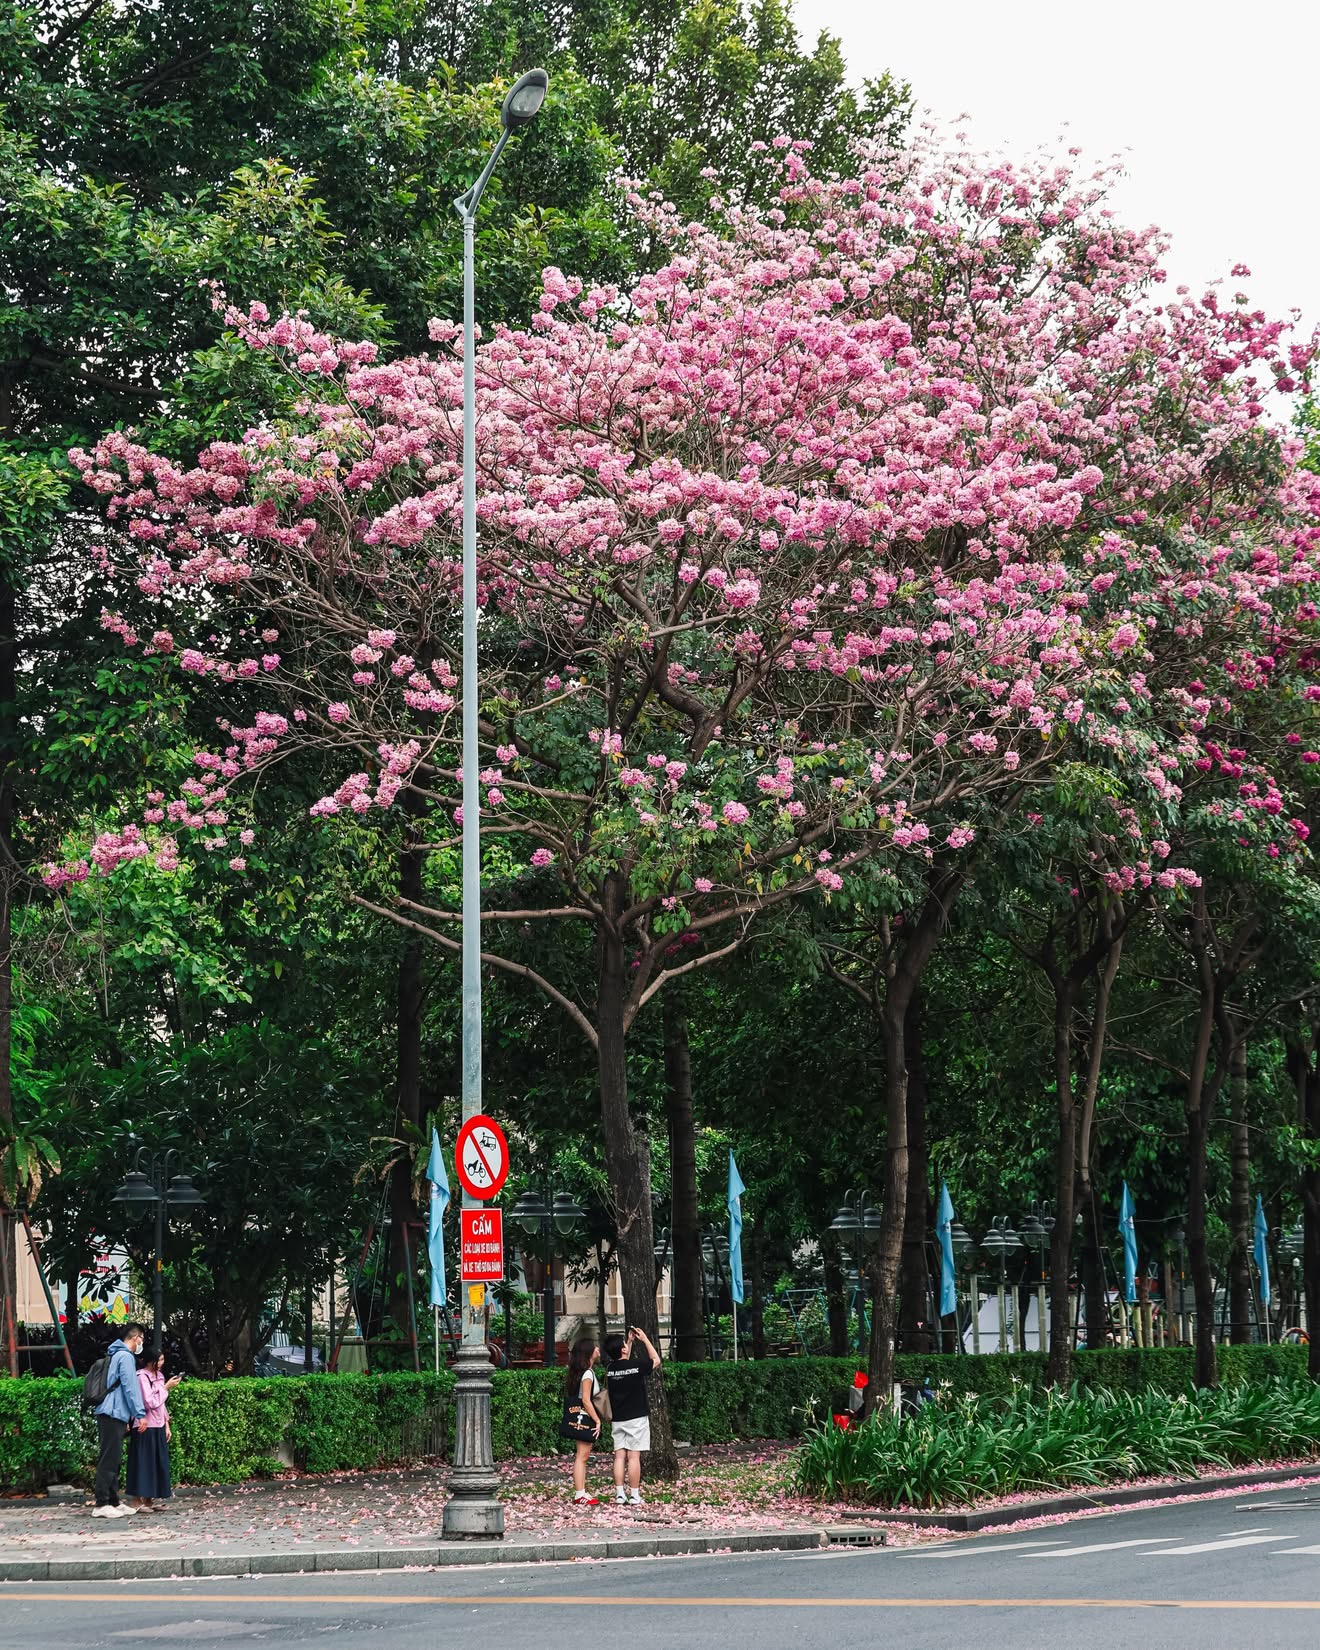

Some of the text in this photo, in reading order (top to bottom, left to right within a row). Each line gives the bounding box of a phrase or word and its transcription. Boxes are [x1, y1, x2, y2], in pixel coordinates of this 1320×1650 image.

[472, 1213, 492, 1235] CẤM
[464, 1240, 472, 1254] CÁC
[481, 1243, 485, 1254] XE
[491, 1240, 500, 1254] BÁNH
[469, 1262, 474, 1273] XE
[492, 1259, 501, 1273] BÁNH
